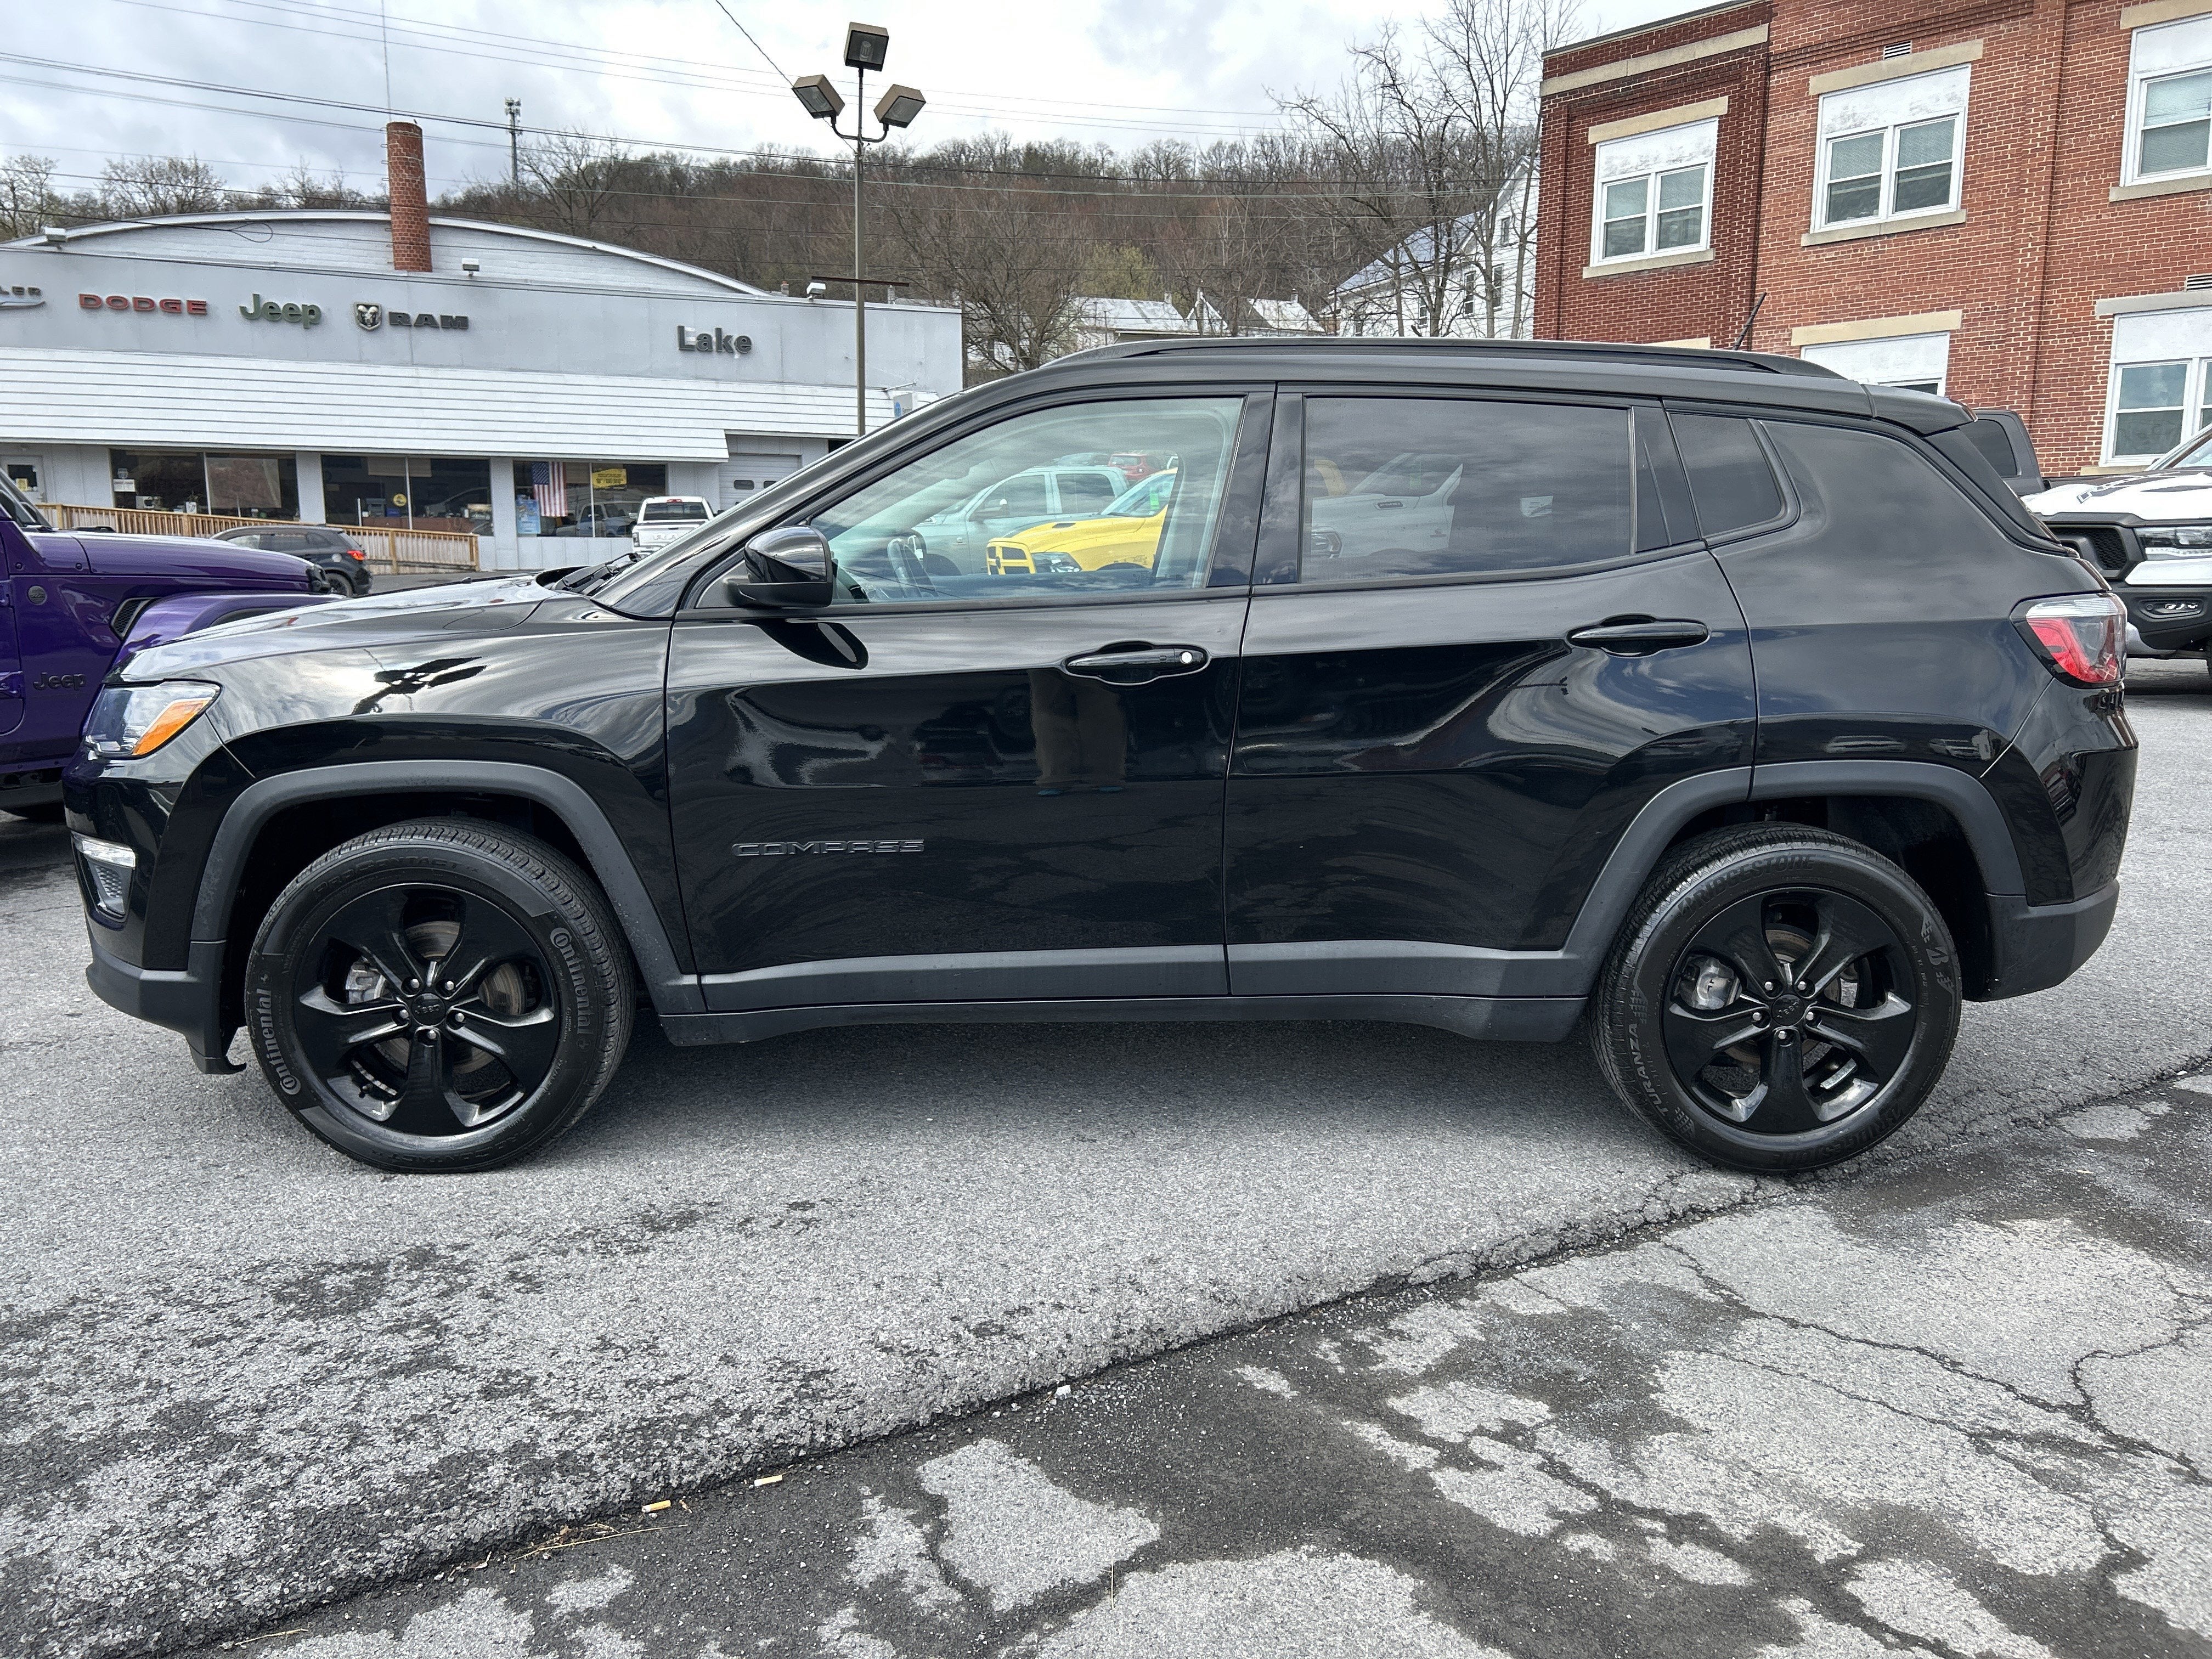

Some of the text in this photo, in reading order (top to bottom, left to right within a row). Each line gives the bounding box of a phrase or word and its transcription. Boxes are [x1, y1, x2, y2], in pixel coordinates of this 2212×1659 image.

[78, 293, 207, 315] DODGE
[239, 294, 322, 329] Jeep
[388, 311, 469, 329] RAM
[678, 325, 752, 353] Lake
[33, 672, 86, 691] Jeep
[732, 839, 924, 856] COMPASS
[1677, 854, 1816, 923] BRIDGESTONE
[550, 927, 594, 1035] Continental
[256, 988, 301, 1095] Continental
[1628, 1023, 1668, 1116] TURANZA
